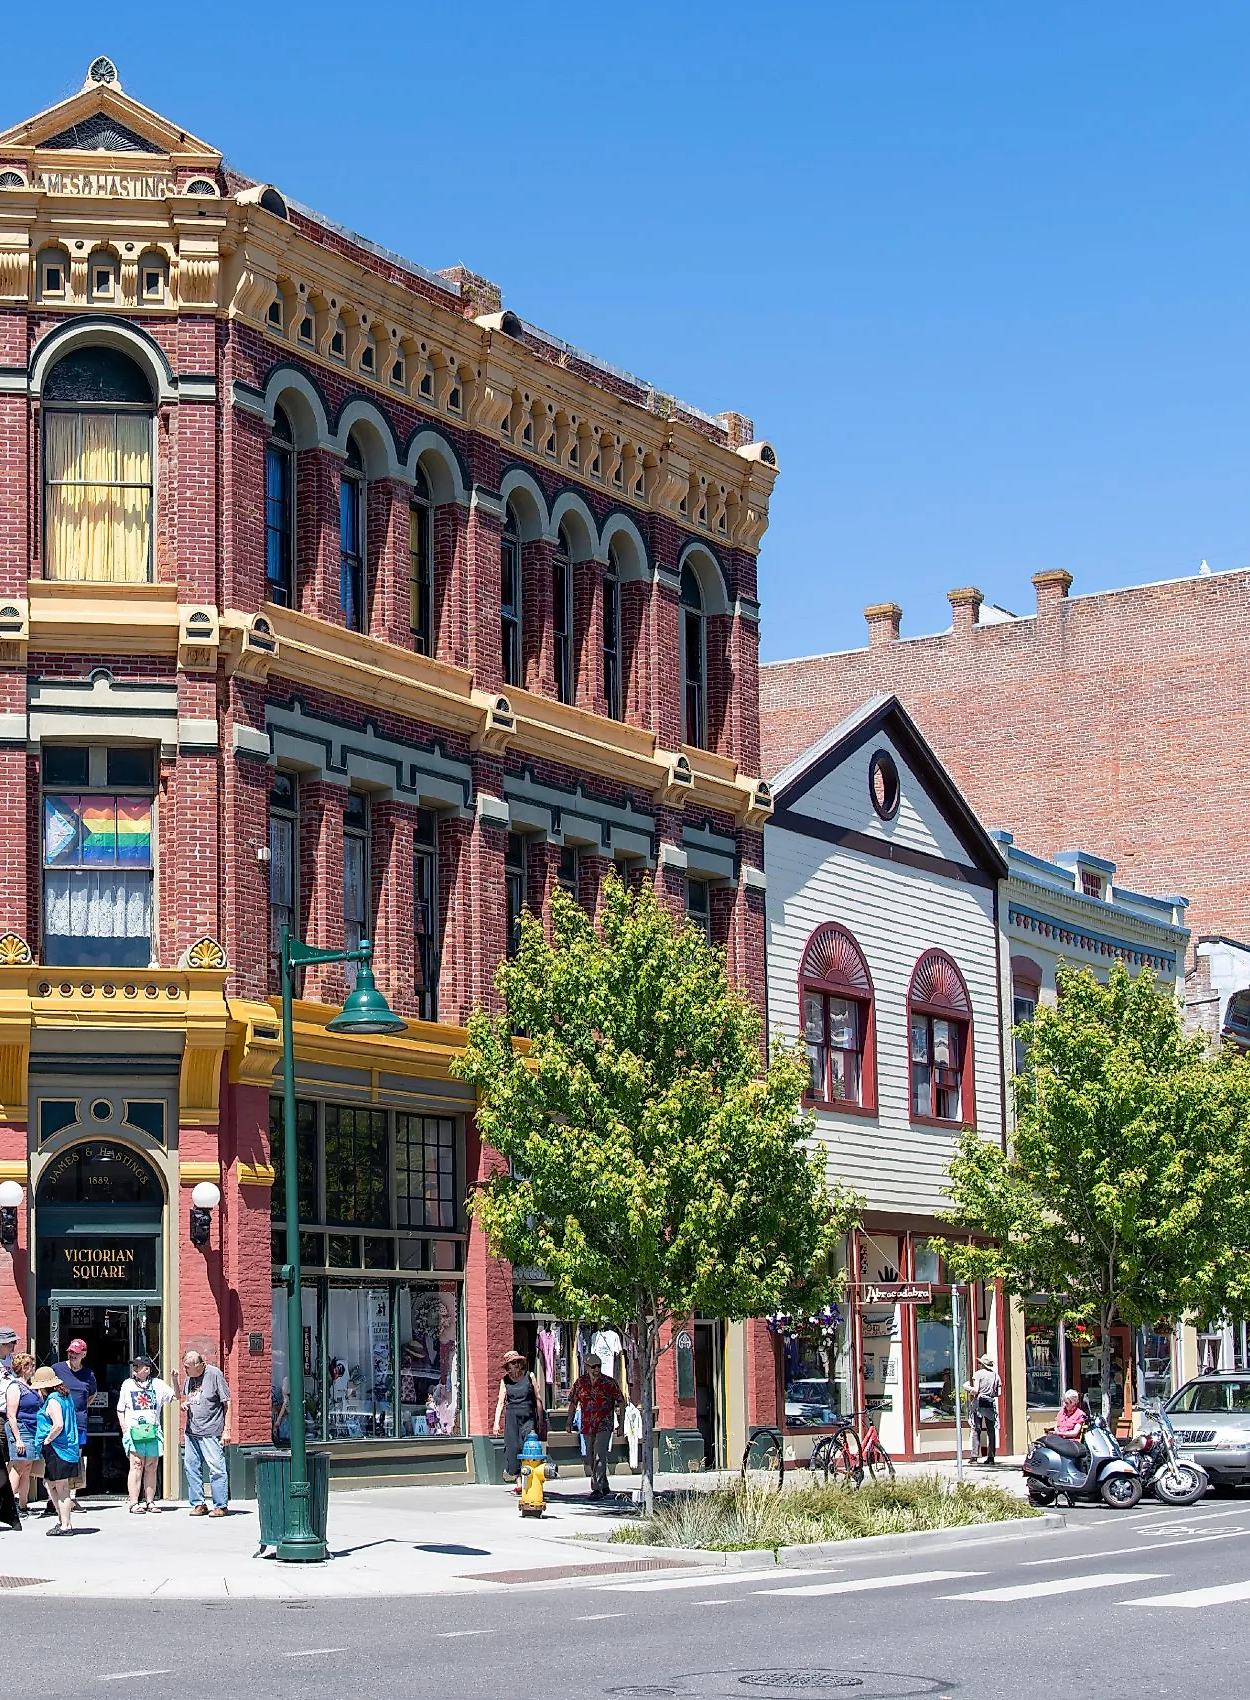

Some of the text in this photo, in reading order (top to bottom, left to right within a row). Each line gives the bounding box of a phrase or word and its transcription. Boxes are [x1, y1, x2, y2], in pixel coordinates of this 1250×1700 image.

[49, 1147, 149, 1185] JAMES & HASTINGS
[63, 1248, 134, 1262] VICTORIAN
[72, 1265, 126, 1279] SQUARE
[866, 1285, 929, 1302] Abracadabra
